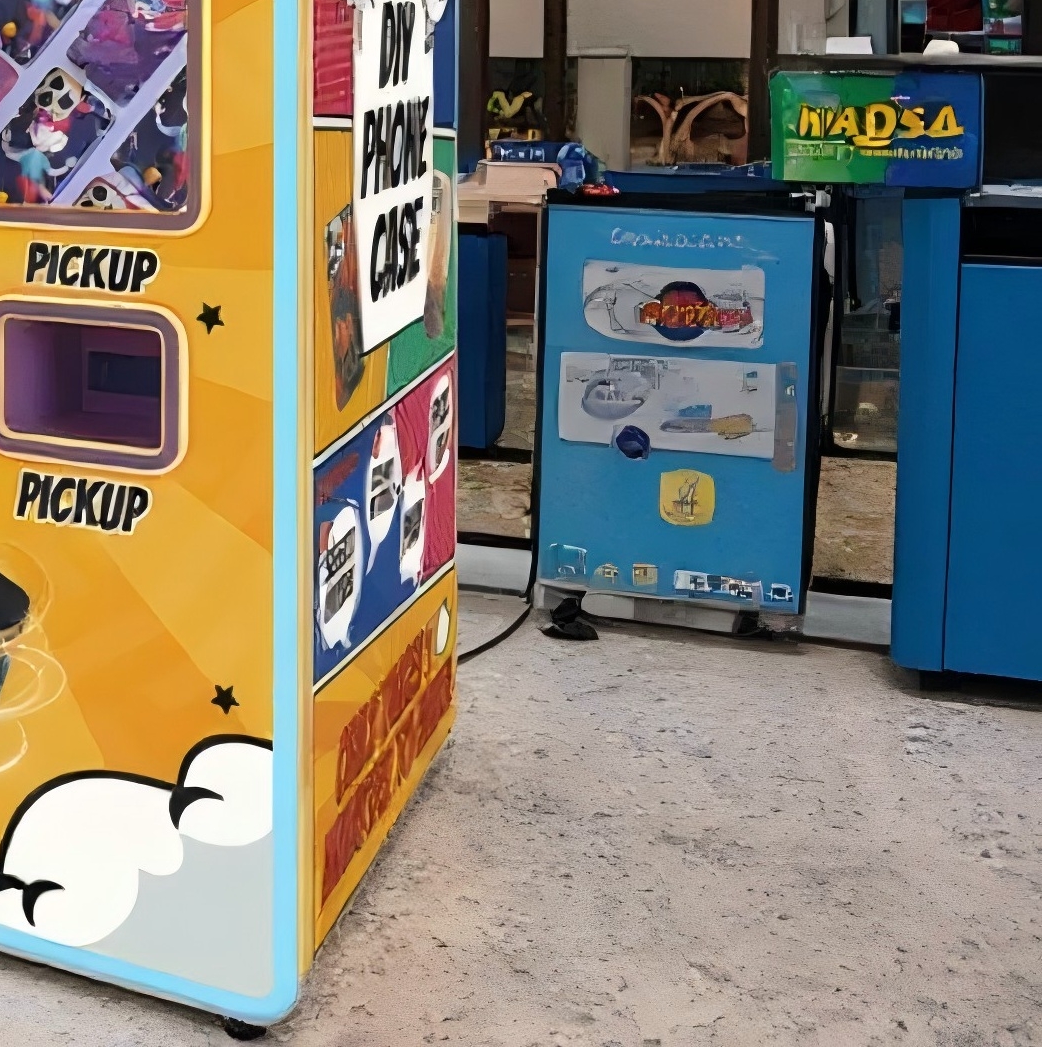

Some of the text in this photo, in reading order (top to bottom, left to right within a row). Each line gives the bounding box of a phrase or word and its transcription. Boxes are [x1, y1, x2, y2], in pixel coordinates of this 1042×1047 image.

[378, 1, 416, 90] DIY
[360, 96, 430, 200] PHONE
[26, 242, 158, 294] PICKUP
[370, 196, 425, 304] CASE
[16, 471, 149, 532] PICKUP
